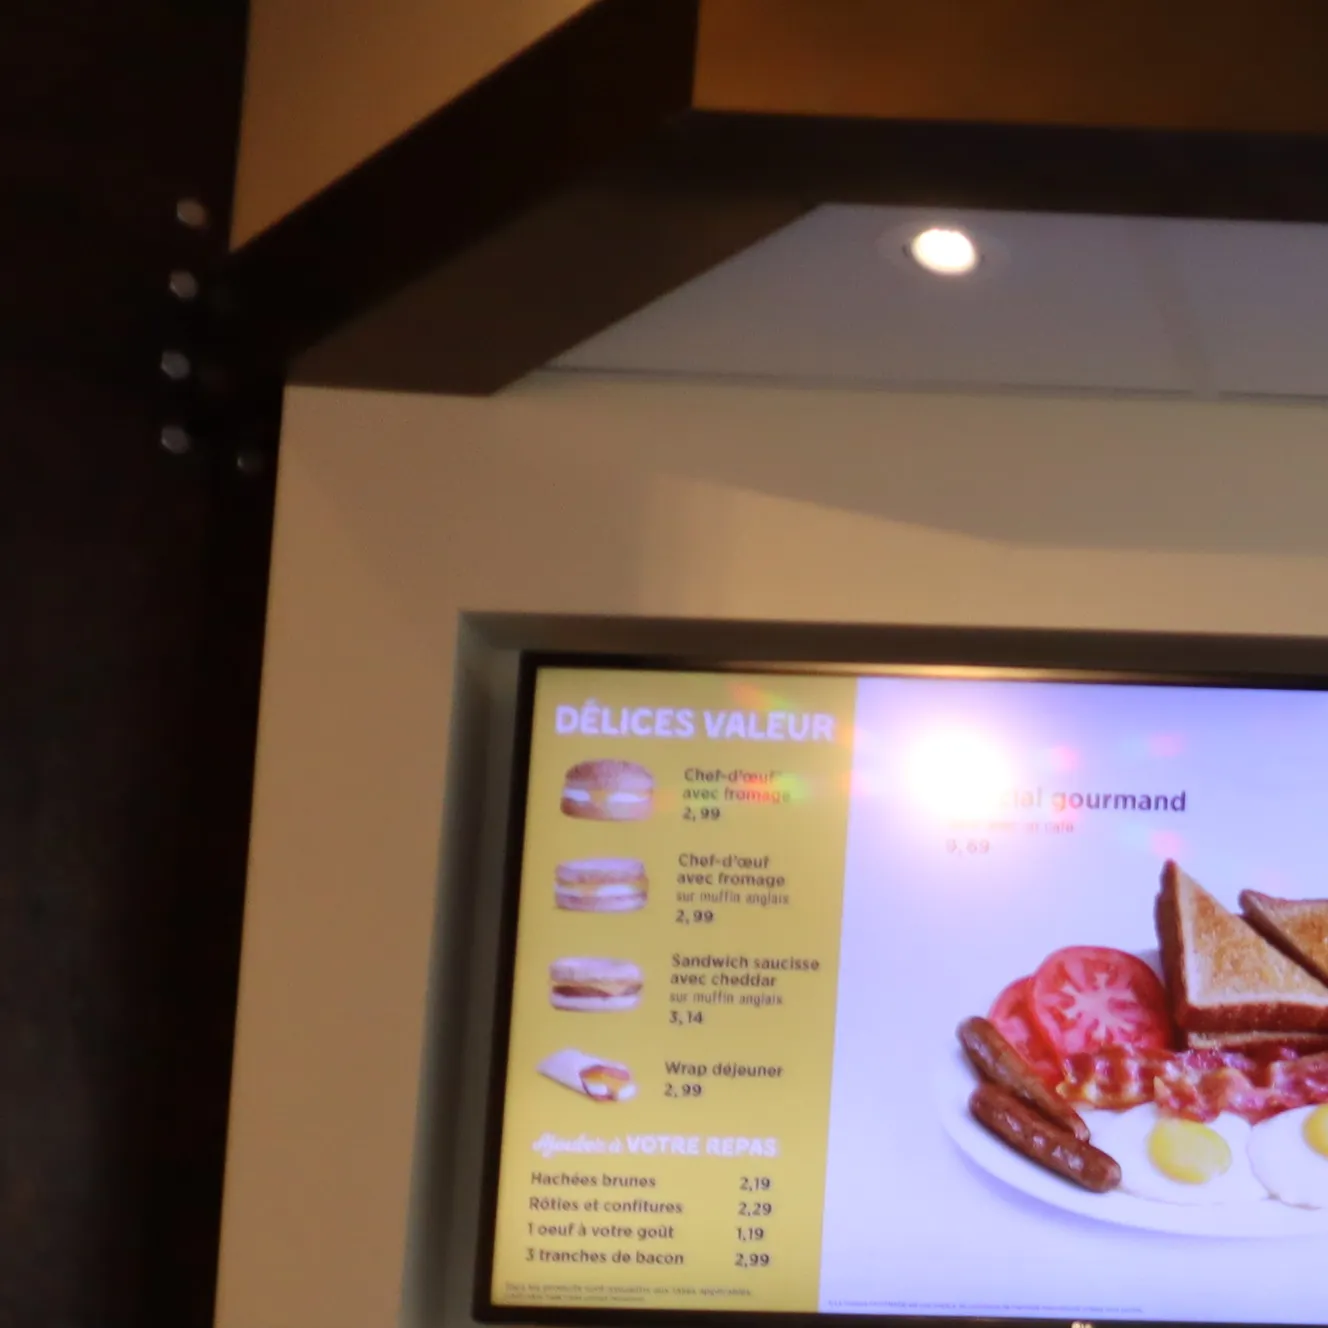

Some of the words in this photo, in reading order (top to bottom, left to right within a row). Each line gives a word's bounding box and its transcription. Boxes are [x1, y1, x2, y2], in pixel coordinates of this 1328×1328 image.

[555, 698, 695, 737] DÉLICES
[704, 711, 836, 741] VALEUR
[677, 874, 713, 885] avec
[718, 872, 785, 889] fromage
[671, 954, 748, 970] Sandwich
[753, 957, 820, 971] saucisse
[670, 974, 706, 985] avec
[711, 972, 776, 987] cheddar
[665, 1062, 708, 1078] Wrap
[713, 1063, 783, 1079] déjeuner
[626, 1135, 700, 1156] VOTRE
[706, 1136, 779, 1157] REPAS
[531, 1172, 597, 1187] Hachées
[602, 1174, 656, 1189] brunes
[739, 1177, 771, 1192] 2,19
[584, 1200, 600, 1212] et
[604, 1199, 683, 1215] confitures
[738, 1203, 772, 1218] 2,29
[591, 1226, 633, 1239] votre
[526, 1248, 536, 1262] 3
[539, 1248, 607, 1264] tranches
[611, 1250, 631, 1264] de
[635, 1251, 684, 1265] bacon
[734, 1253, 770, 1268] 2,99
